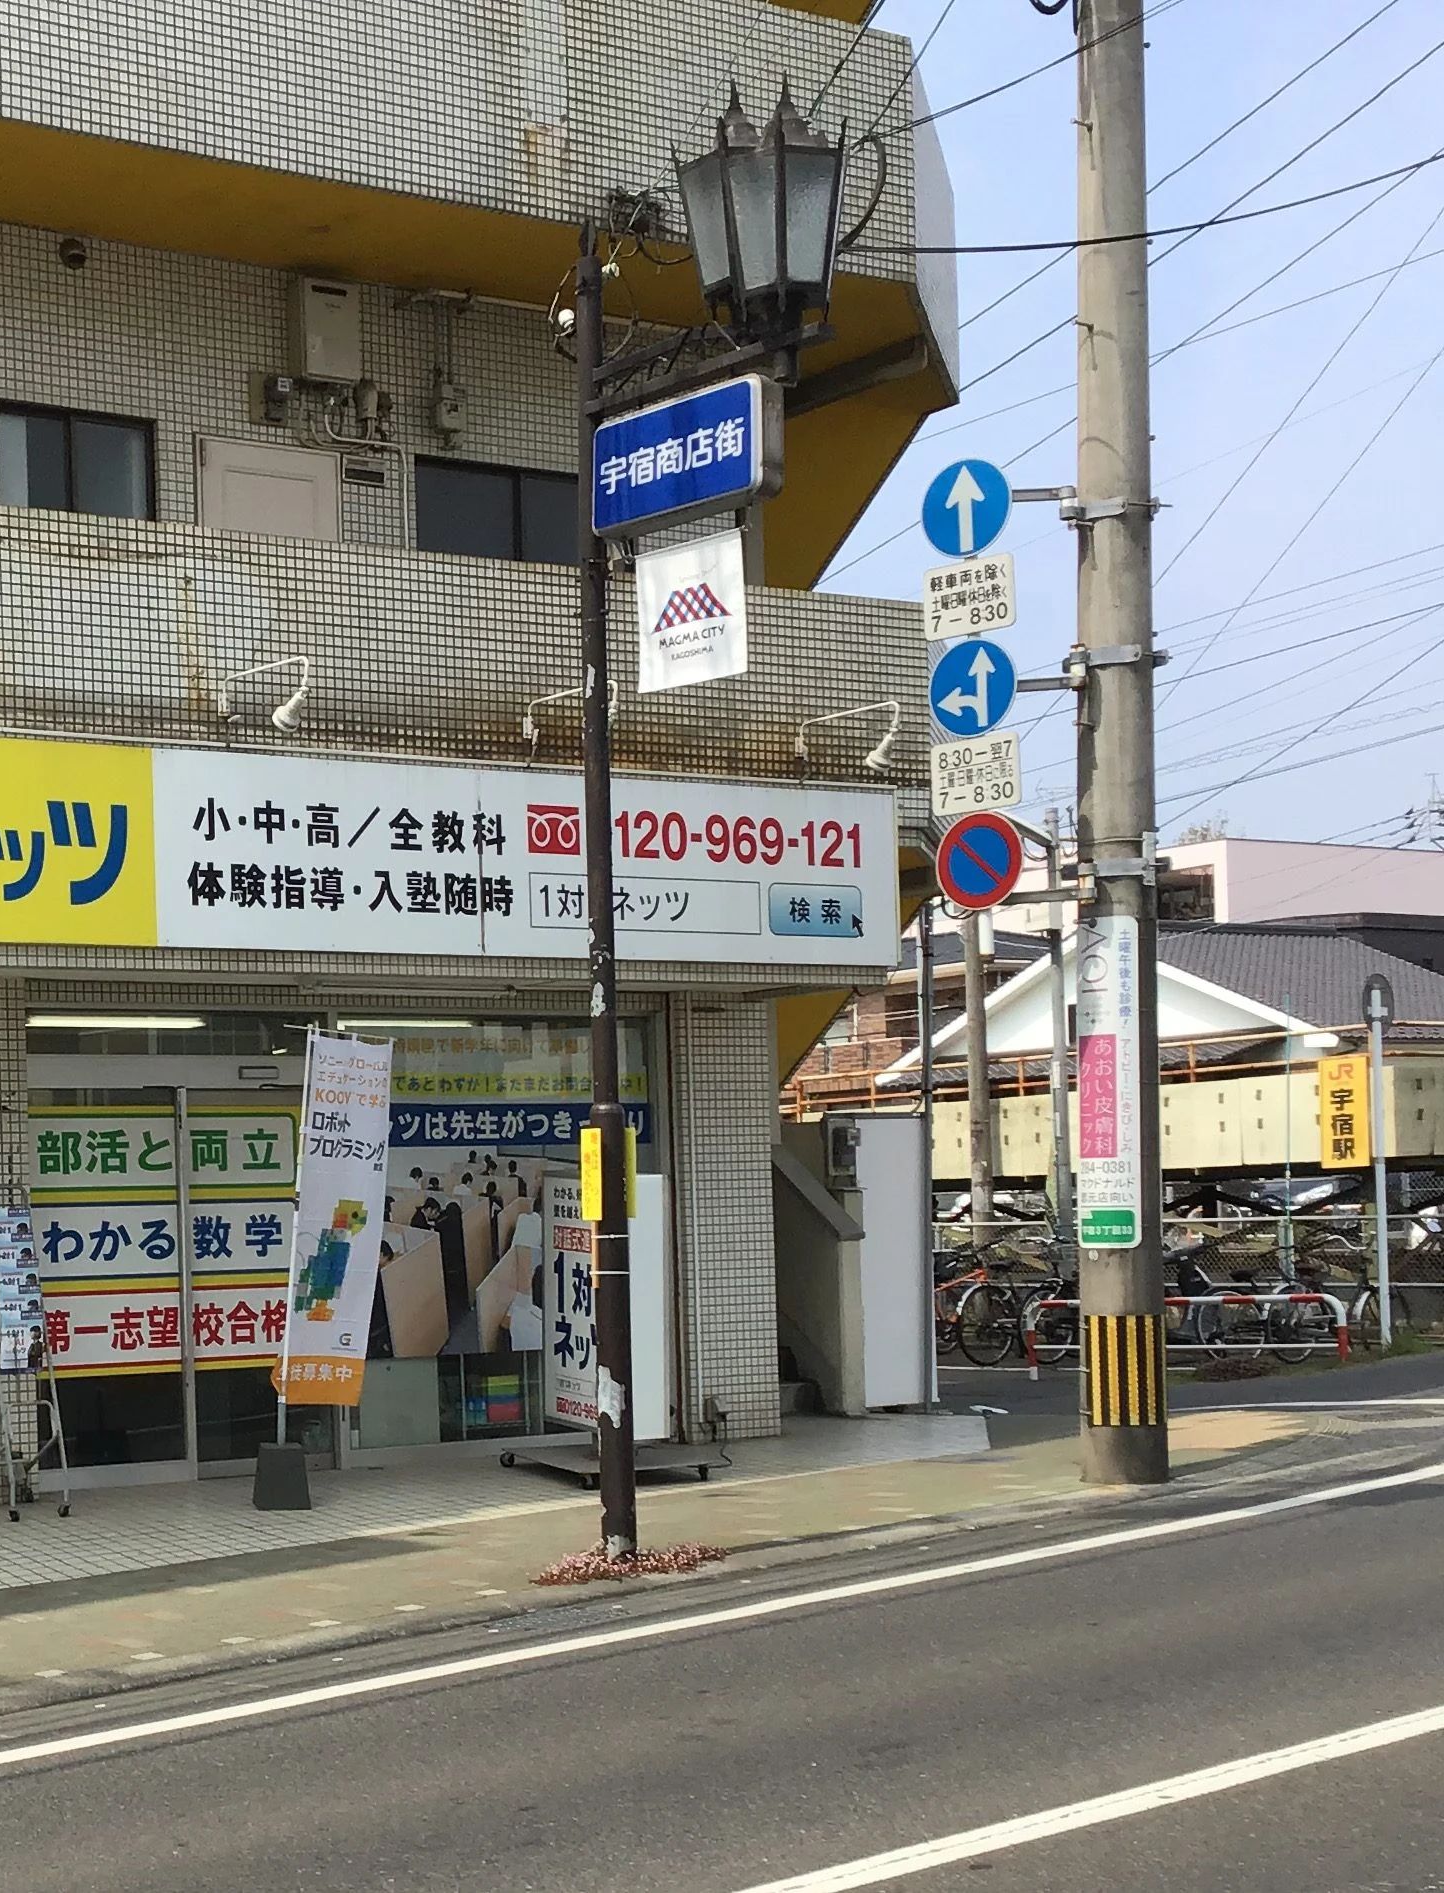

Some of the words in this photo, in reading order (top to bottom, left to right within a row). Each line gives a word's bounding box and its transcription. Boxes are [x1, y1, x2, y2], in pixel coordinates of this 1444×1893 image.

[600, 417, 745, 495] 宇宿商店街
[930, 563, 1007, 592] 軽車両を除く
[658, 631, 700, 650] MAGMA
[702, 624, 726, 641] CITY
[670, 645, 715, 661] KAGOSHIMA
[614, 810, 861, 868] 120-969-121
[188, 861, 513, 917] 体験指導・入塾随時
[539, 883, 690, 922] 1対ネッツ
[789, 897, 843, 924] 検索
[1081, 926, 1108, 993] AOI
[1328, 1063, 1355, 1081] JR
[1081, 1061, 1094, 1154] クリニック
[1094, 1039, 1115, 1154] あおい皮膚科
[311, 1110, 352, 1133] ロボット
[388, 1110, 644, 1141] ツは先生がつきり
[1330, 1088, 1356, 1160] 宇宿駅
[37, 1128, 282, 1175] 部活と両立
[309, 1136, 386, 1162] プログラミング
[1081, 1177, 1136, 1189] マクドナルド
[42, 1214, 283, 1263] わかる数学
[45, 1300, 288, 1354] 第一志望校合格
[554, 1318, 599, 1370] ネッ
